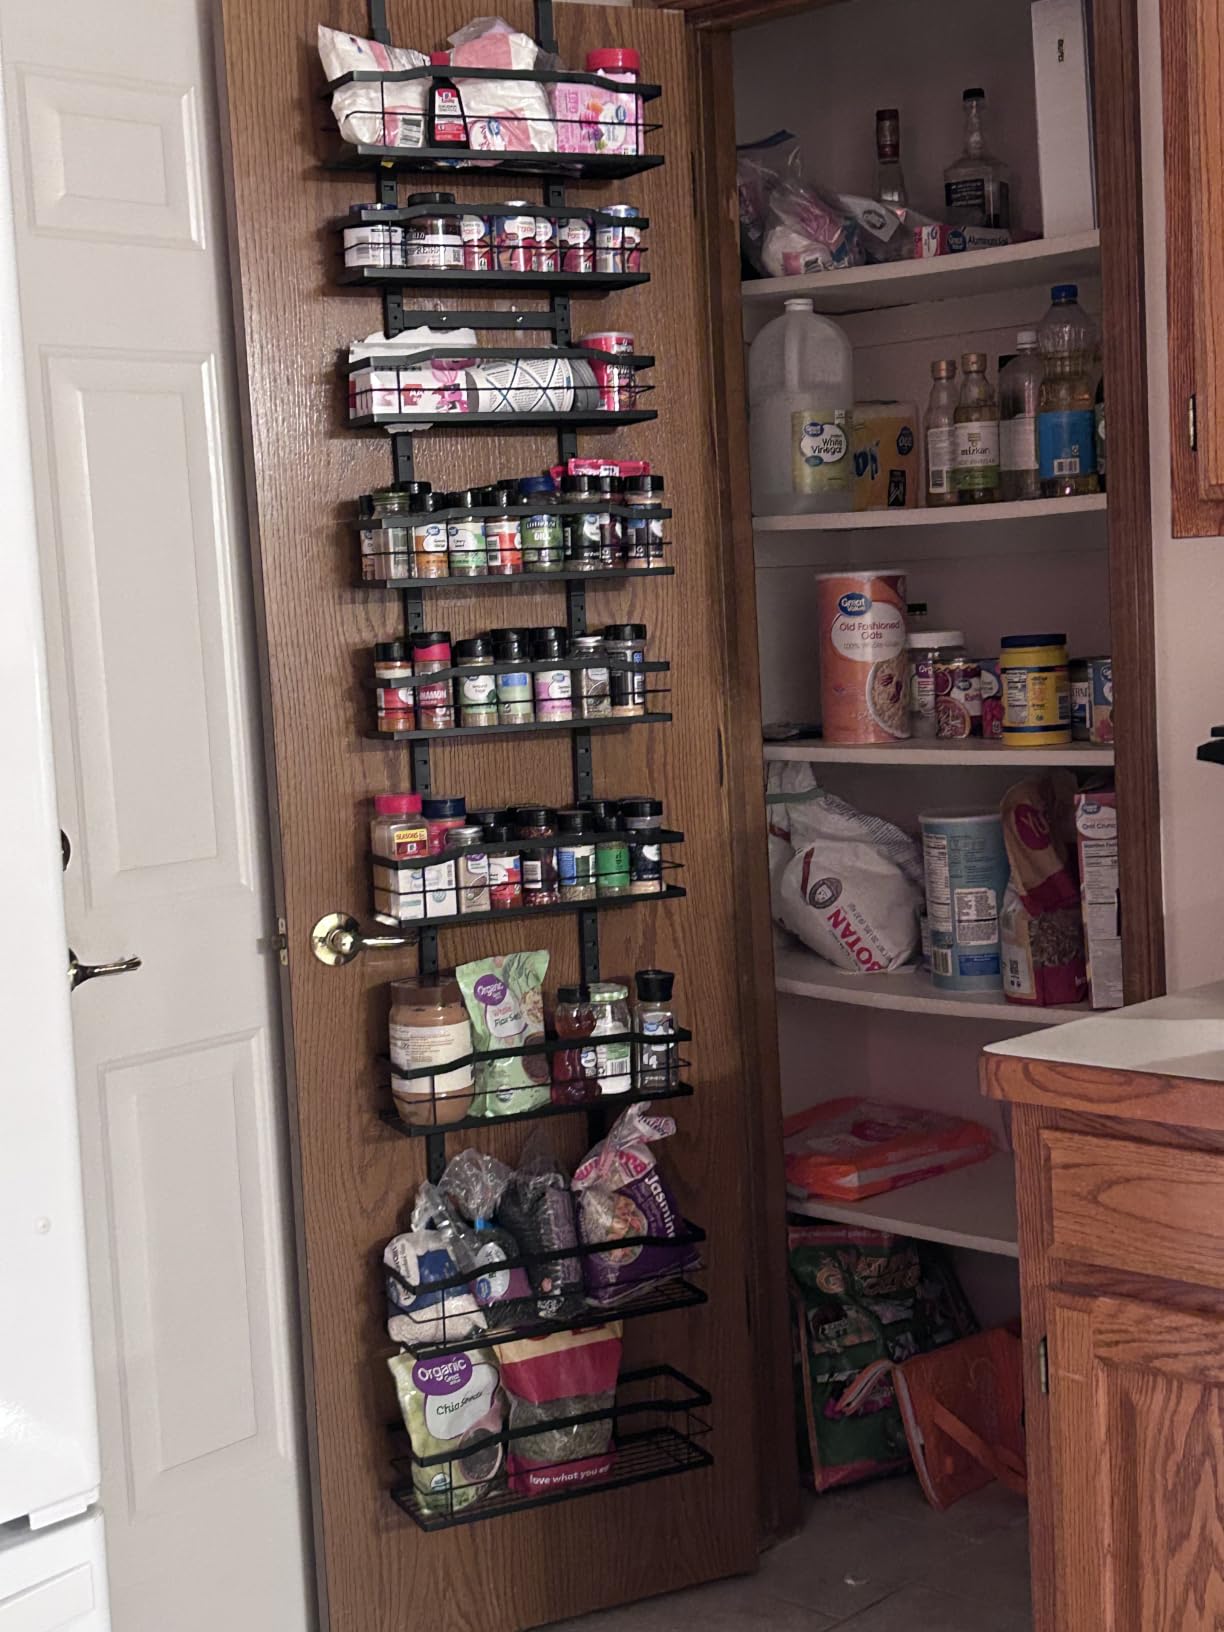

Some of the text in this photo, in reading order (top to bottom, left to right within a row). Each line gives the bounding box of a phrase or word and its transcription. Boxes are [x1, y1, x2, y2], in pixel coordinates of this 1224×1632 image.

[811, 445, 843, 455] Vinegar
[841, 598, 865, 607] Great
[840, 621, 900, 631] Old Fashioned
[861, 631, 882, 640] Oats
[827, 909, 881, 971] BOTAN
[477, 982, 504, 997] Organic
[417, 1357, 467, 1381] Organic
[436, 1401, 461, 1415] Chia
[529, 1474, 551, 1485] love
[552, 1471, 579, 1483] what
[580, 1468, 598, 1479] you
